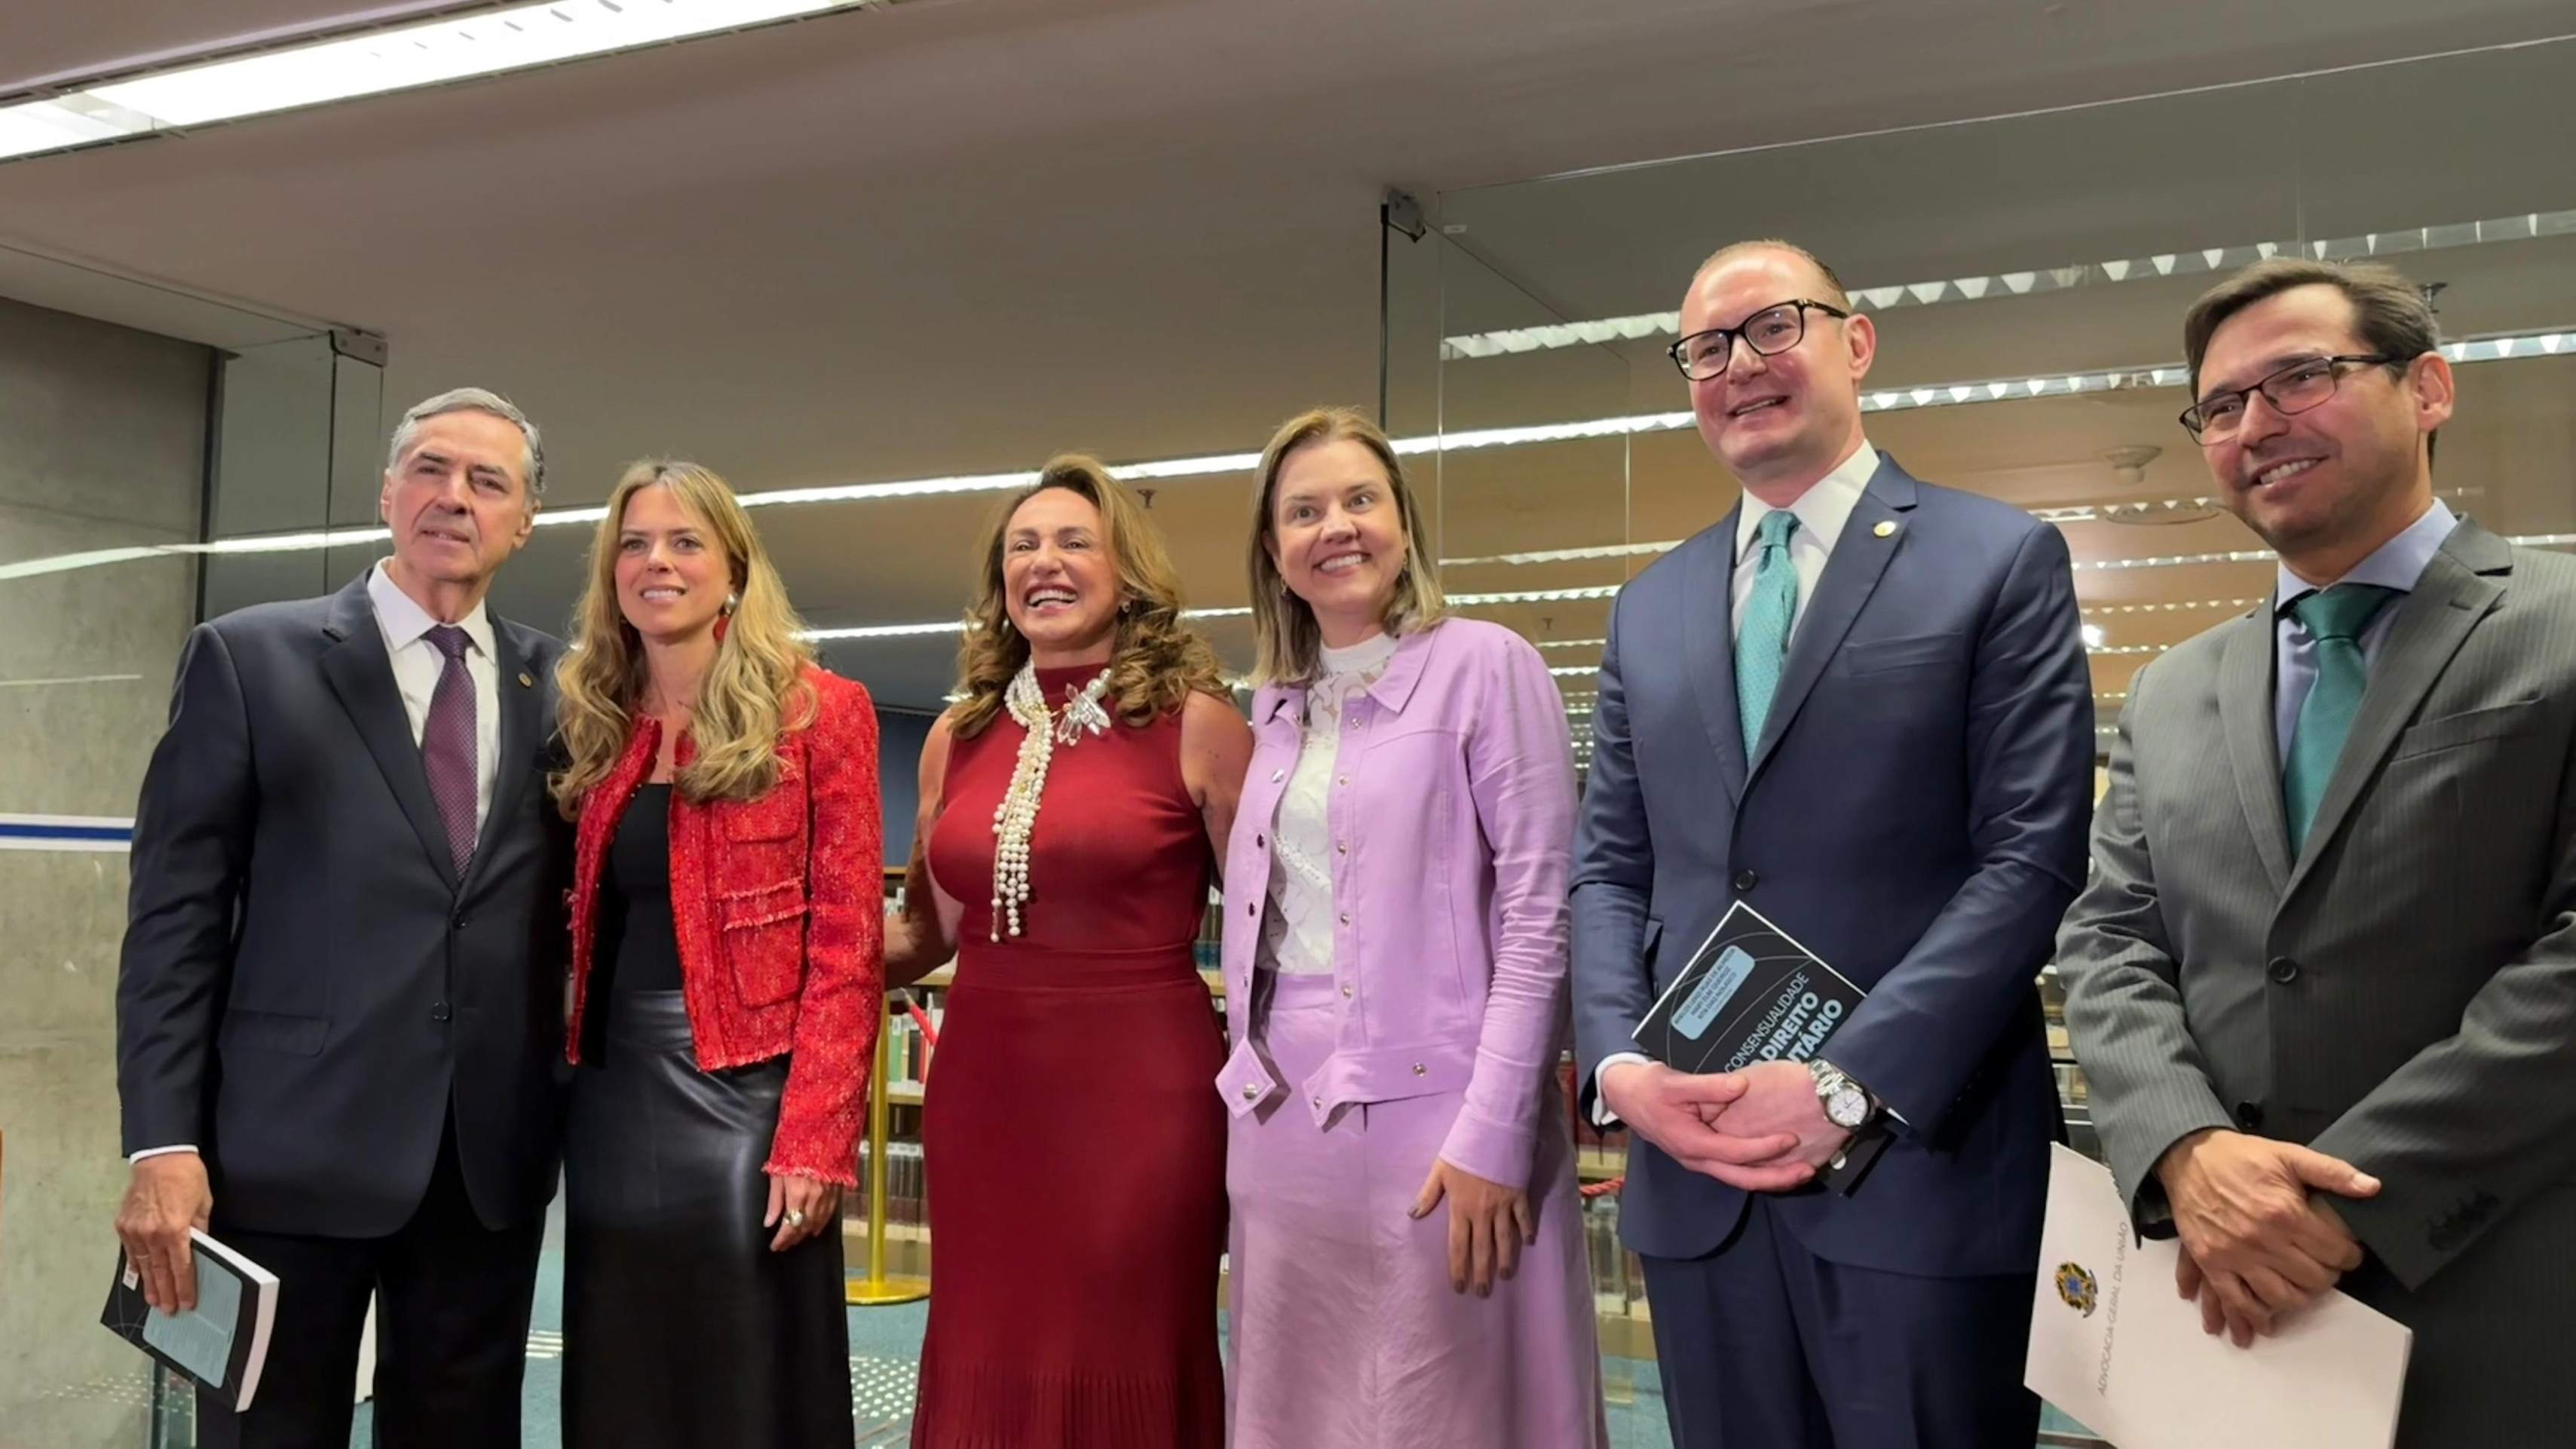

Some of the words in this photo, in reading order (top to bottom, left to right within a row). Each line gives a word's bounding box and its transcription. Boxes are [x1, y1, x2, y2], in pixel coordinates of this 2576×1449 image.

[1724, 972, 1809, 1074] CONSENSUALIDADE
[1760, 991, 1819, 1061] DIREITO
[2113, 1264, 2123, 1282] DA
